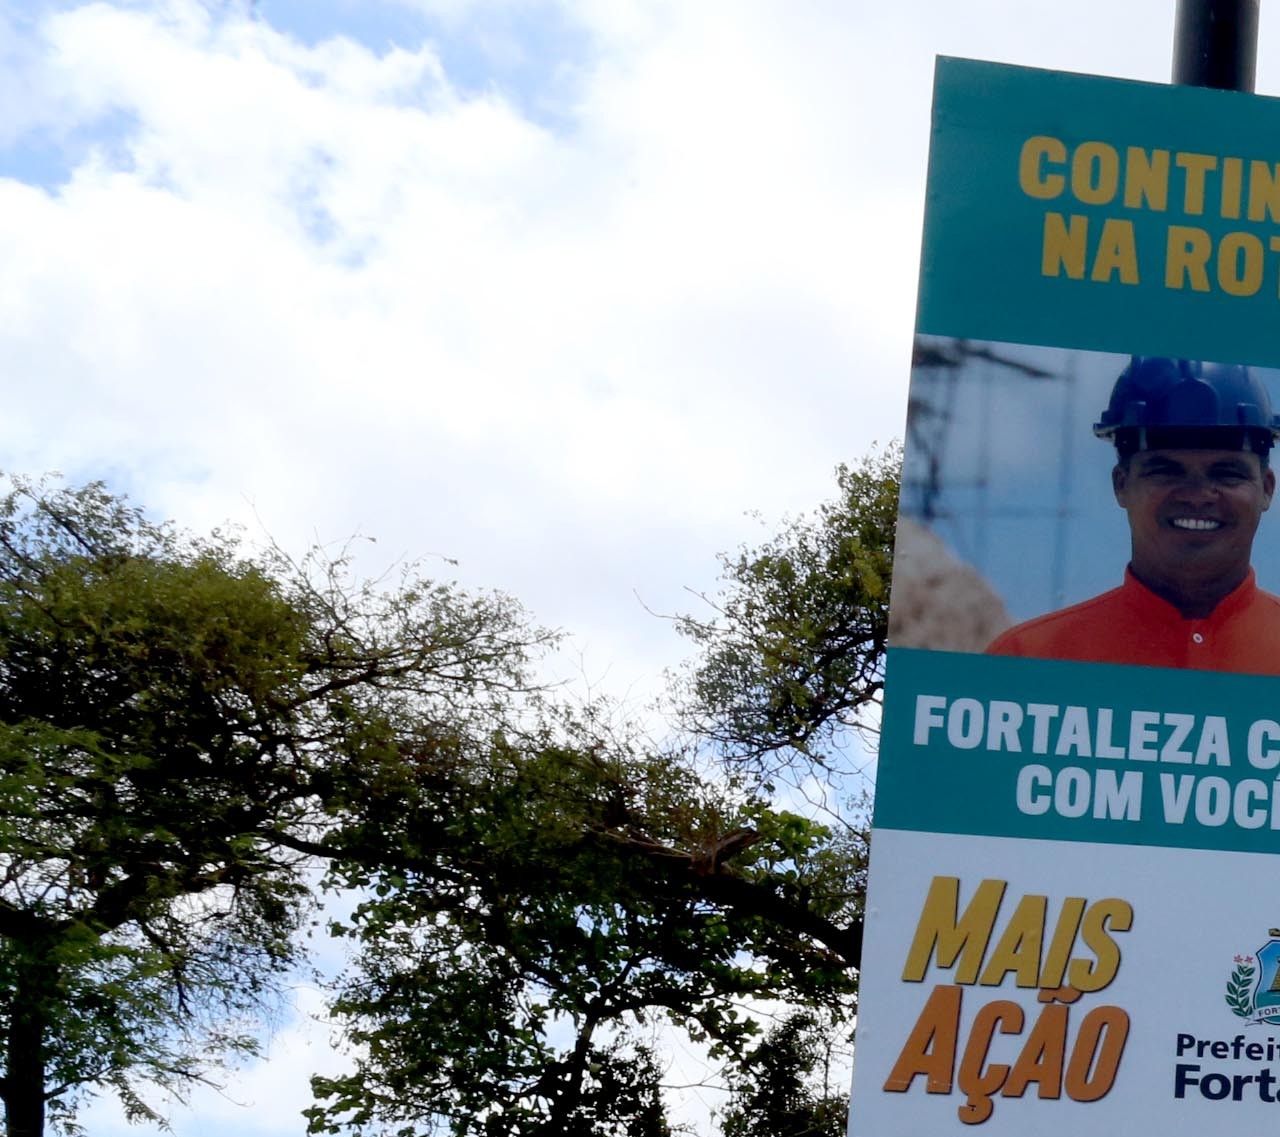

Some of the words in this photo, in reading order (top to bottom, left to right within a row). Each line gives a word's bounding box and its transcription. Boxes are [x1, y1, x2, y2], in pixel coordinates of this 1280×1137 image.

[1041, 212, 1140, 285] NA
[913, 695, 1231, 766] FORTALEZA
[1016, 764, 1143, 821] COM
[902, 876, 1134, 993] MAIS
[882, 984, 1130, 1125] AÇÃO
